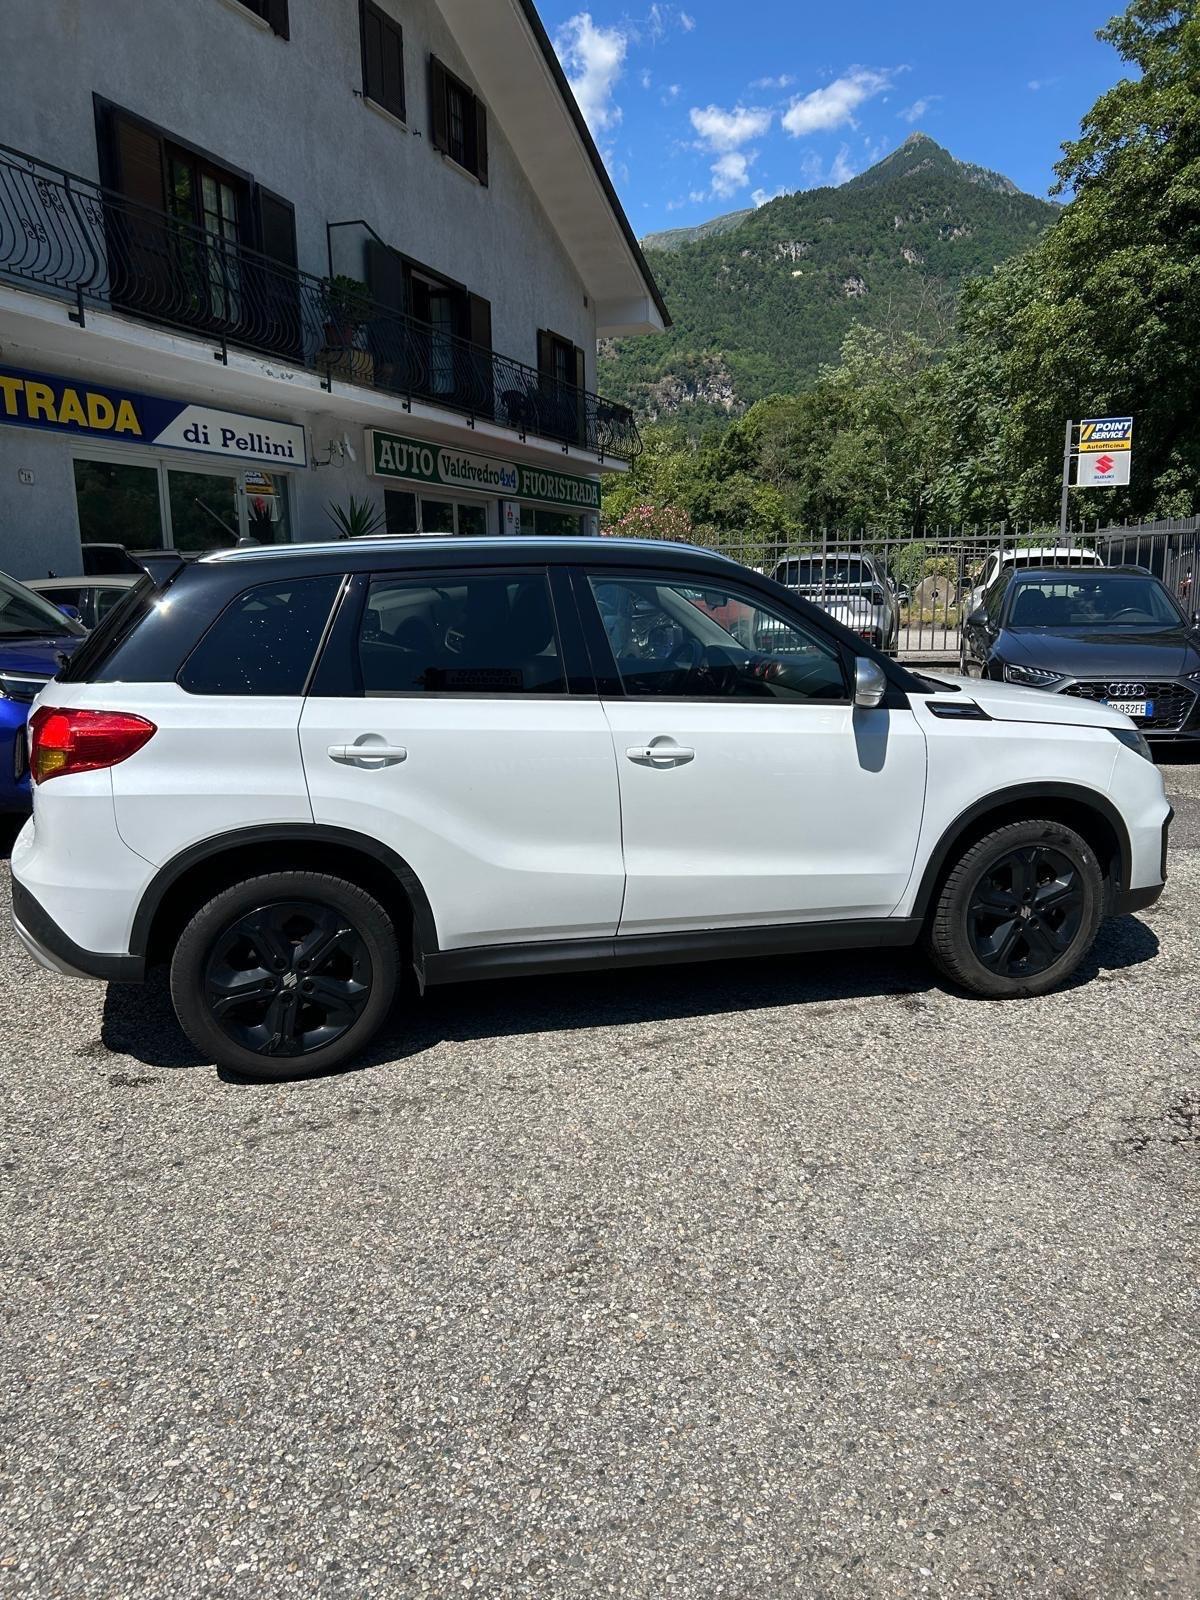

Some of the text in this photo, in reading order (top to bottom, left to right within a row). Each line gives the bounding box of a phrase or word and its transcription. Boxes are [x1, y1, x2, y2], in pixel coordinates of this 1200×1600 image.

[0, 375, 294, 458] TRADA di Pellini
[1096, 421, 1131, 431] POINT
[1091, 431, 1124, 440] SERVICE
[379, 440, 434, 476] AUTO
[522, 470, 598, 505] FUORISTRADA
